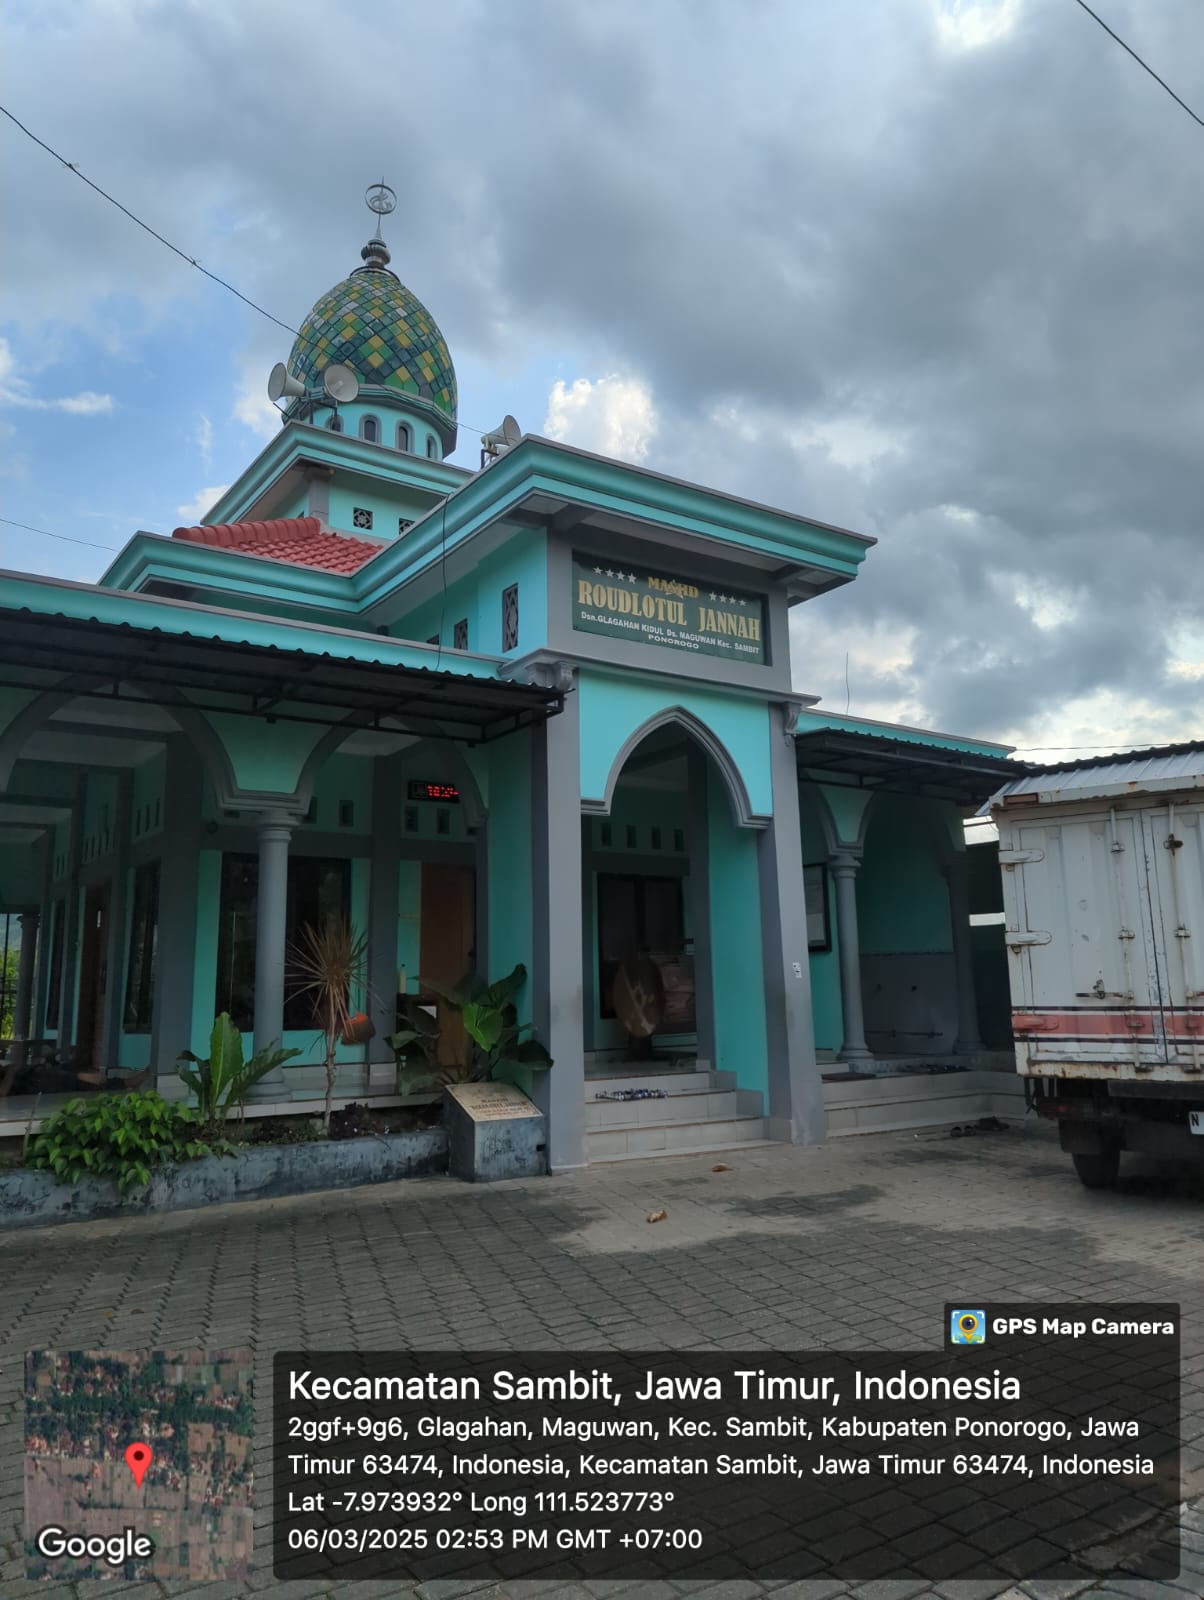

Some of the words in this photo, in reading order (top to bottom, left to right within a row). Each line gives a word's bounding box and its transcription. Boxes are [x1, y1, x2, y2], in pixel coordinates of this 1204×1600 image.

[578, 579, 687, 625] ROUDLOTUL
[698, 606, 760, 641] JANNAH
[641, 623, 664, 636] KIDUL
[666, 628, 678, 638] Ds.
[680, 631, 716, 646] MAGUWAN
[717, 639, 732, 649] Kec.
[734, 642, 760, 655] SAMBIT
[648, 633, 700, 649] PONOROGO
[1191, 1113, 1200, 1127] N
